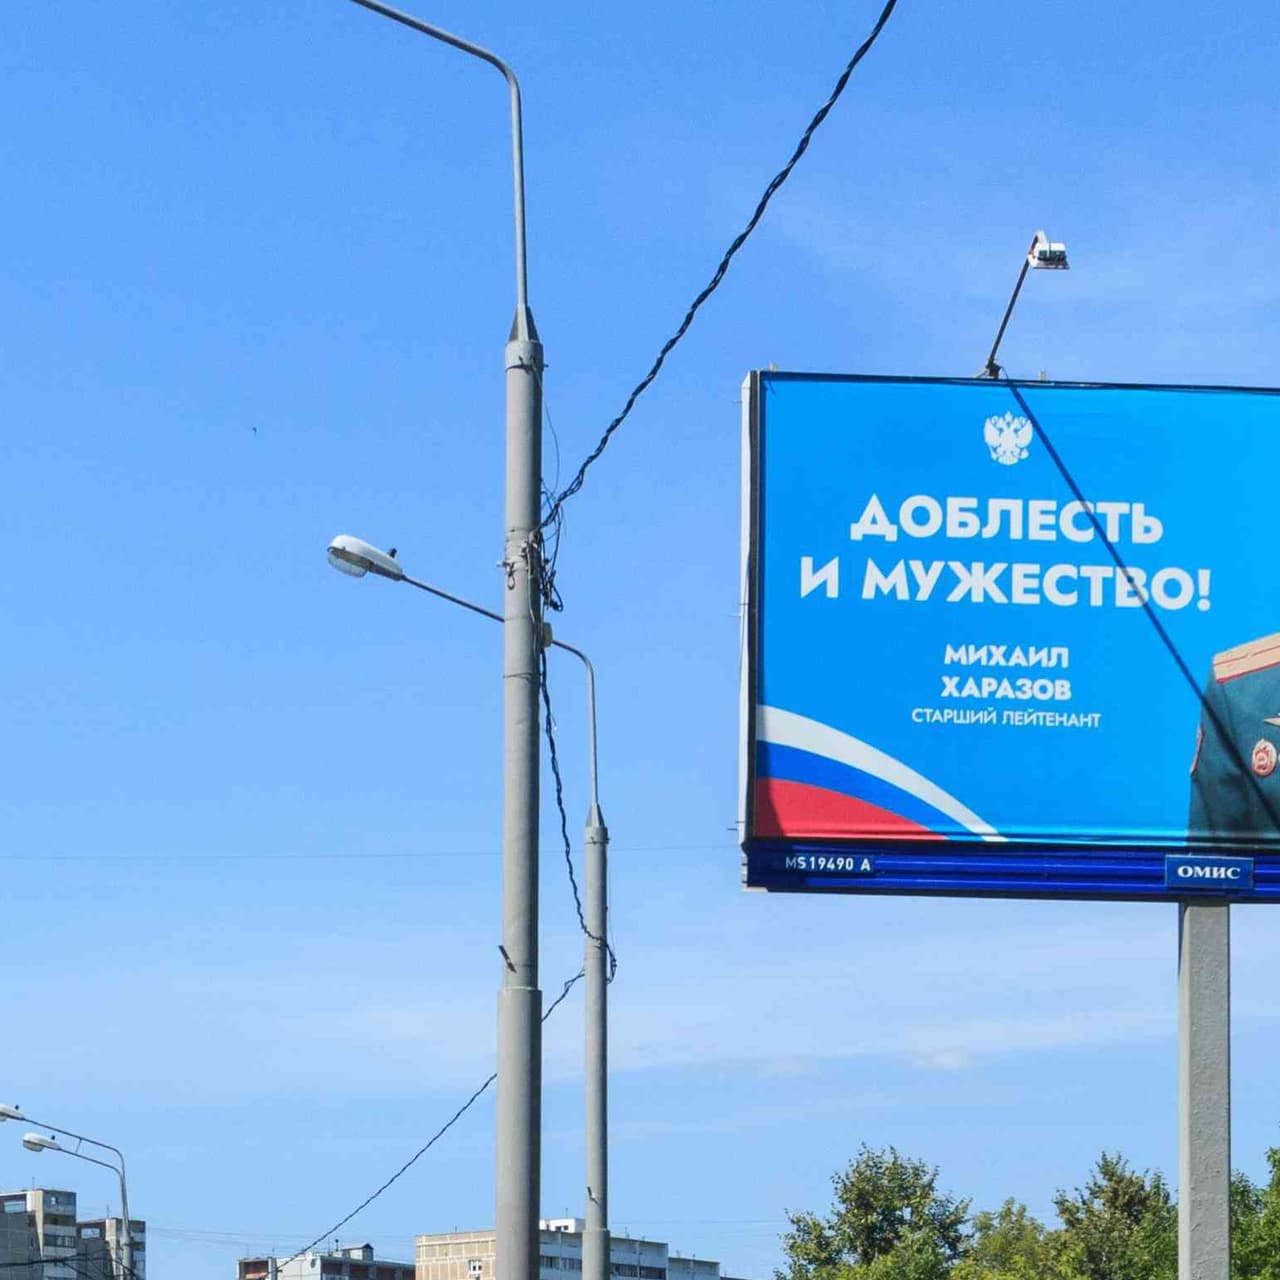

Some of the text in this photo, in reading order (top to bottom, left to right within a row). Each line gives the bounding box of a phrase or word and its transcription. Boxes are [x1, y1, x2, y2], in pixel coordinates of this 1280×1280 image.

[850, 493, 1164, 544] ДОБЛЕСТЬ
[800, 556, 1211, 611] И МУЖЕСТВО!
[943, 644, 1069, 668] МИХАИЛ
[940, 676, 1072, 700] ХАРАЗОВ
[911, 706, 1101, 728] СТАРШИЙ ЛЕЙТЕНАНТ
[1177, 865, 1241, 880] ОМИС
